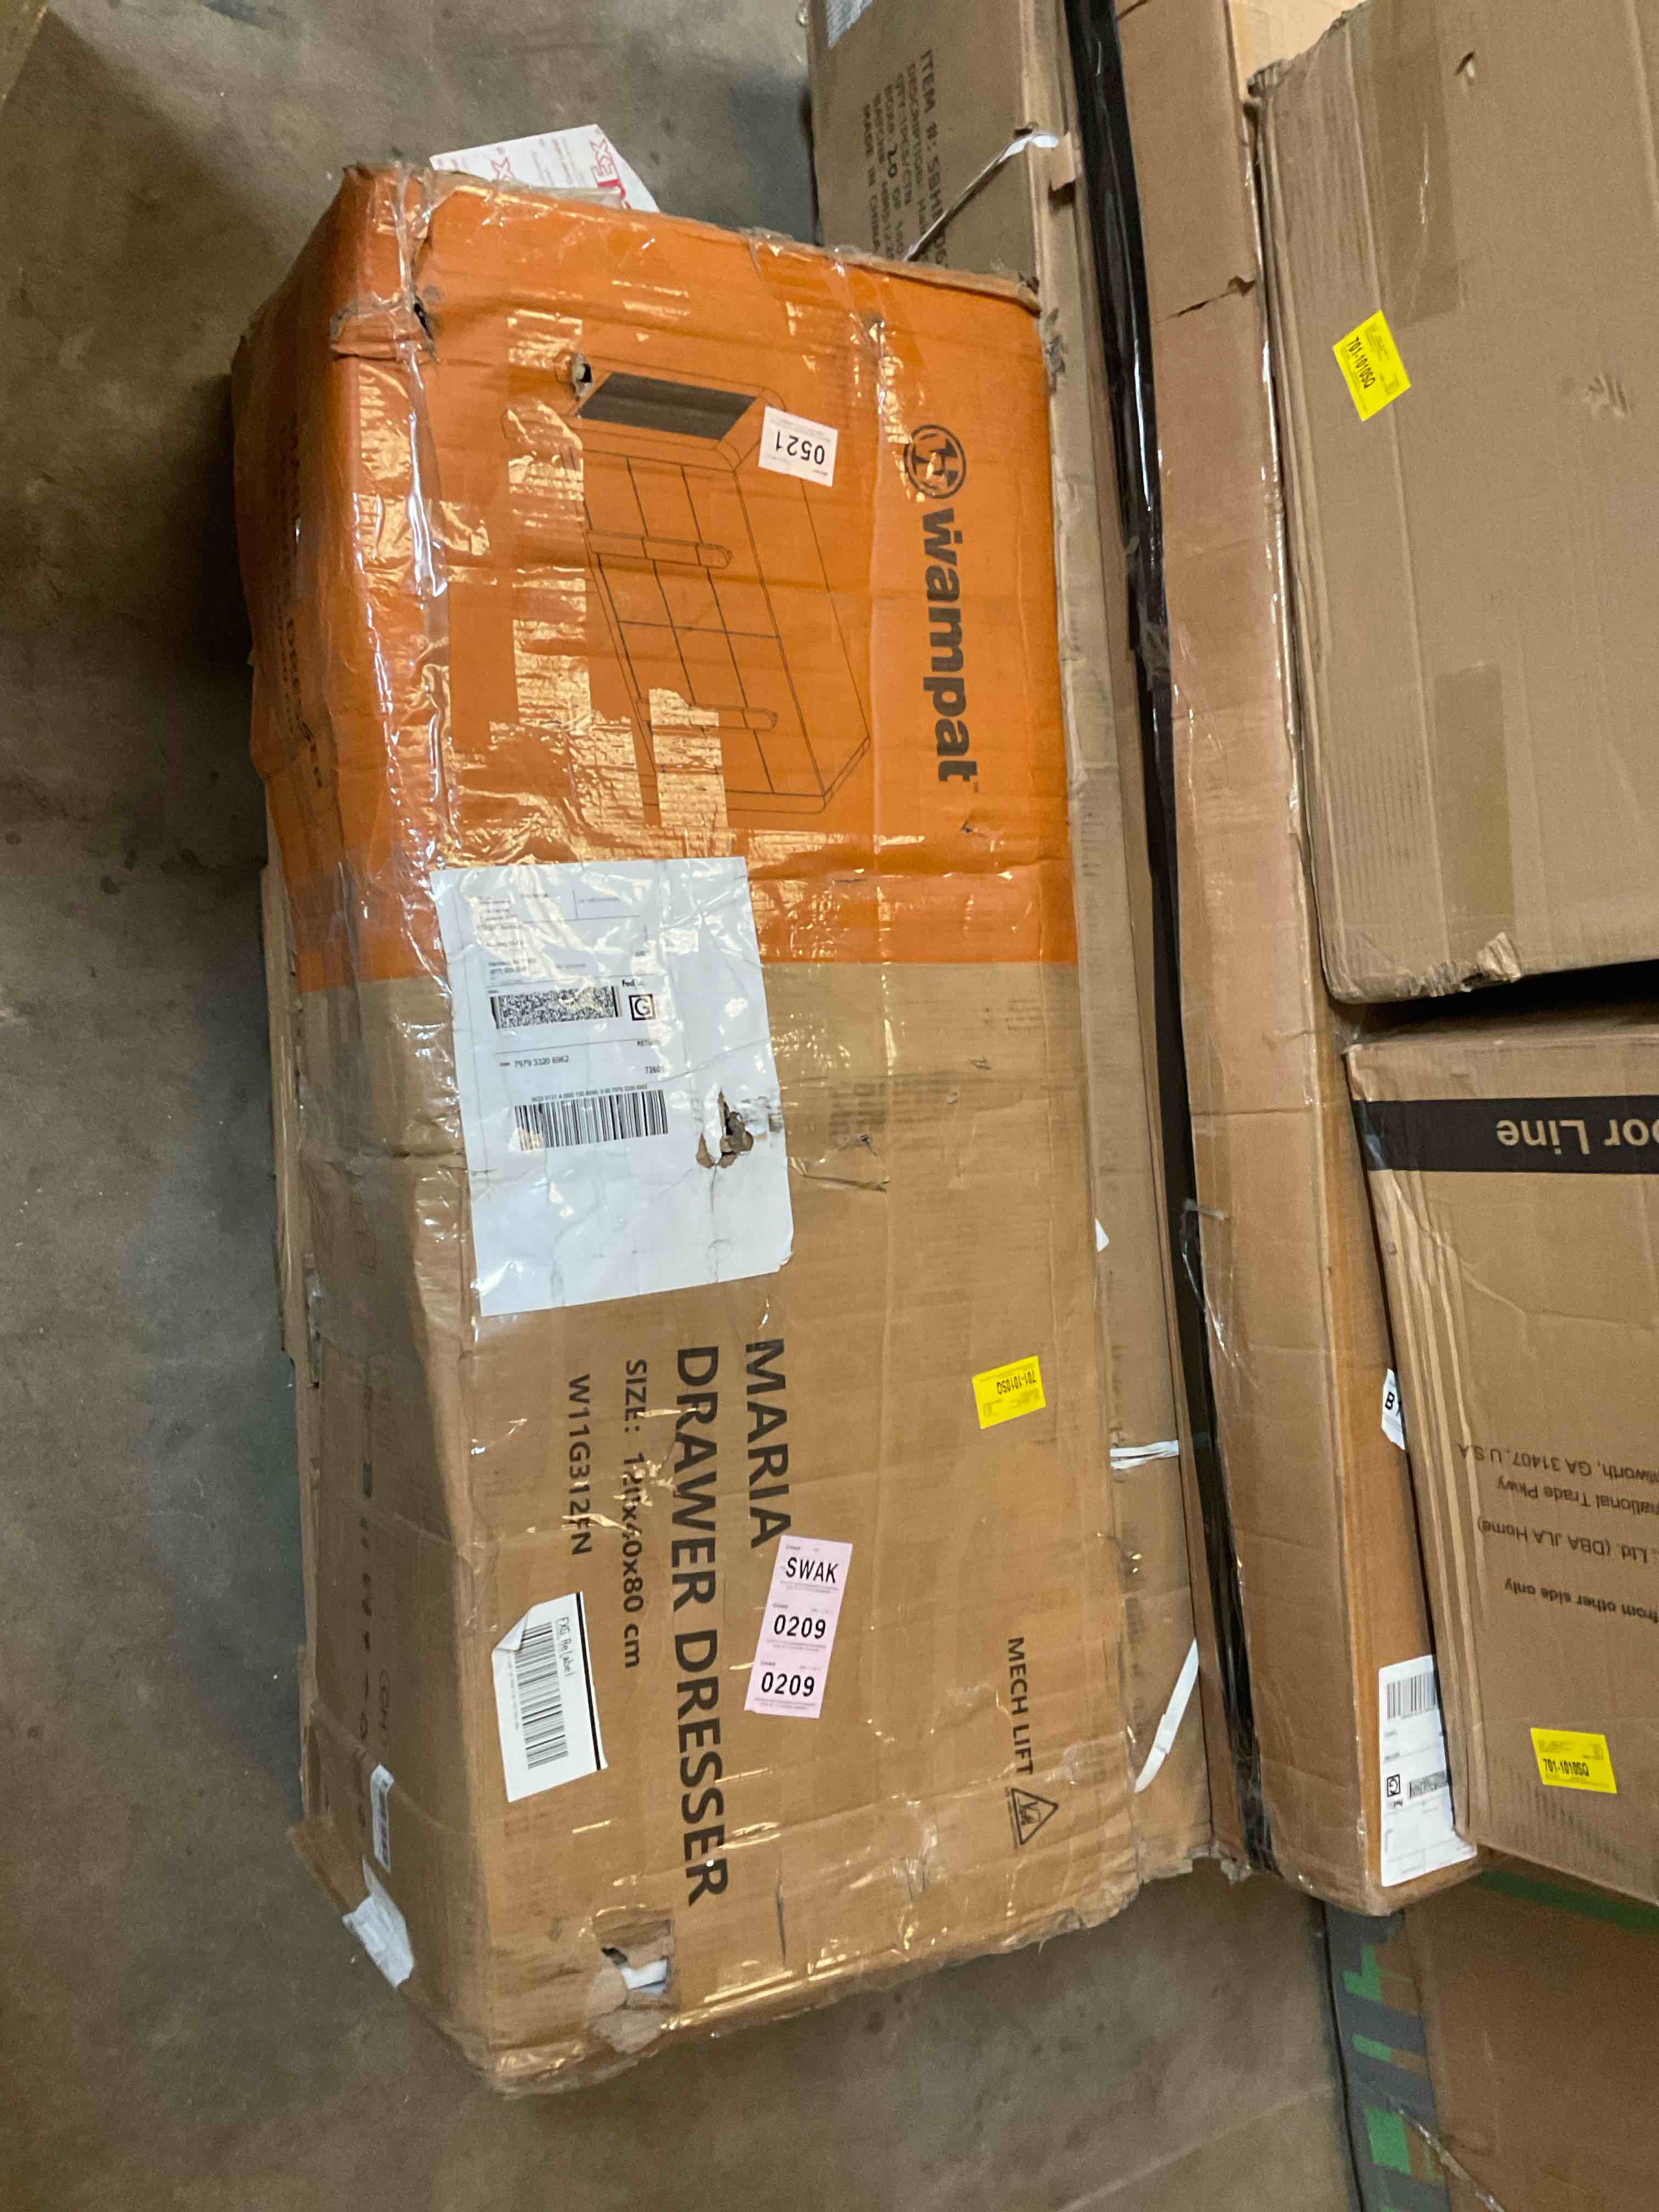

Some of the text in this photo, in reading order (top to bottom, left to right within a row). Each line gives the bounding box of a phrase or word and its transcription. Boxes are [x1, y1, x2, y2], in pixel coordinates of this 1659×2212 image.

[776, 430, 825, 465] 0521
[1496, 1119, 1659, 1155] or Line
[624, 1359, 647, 1433] SIZE:
[745, 1338, 792, 1549] MARIA
[1564, 1457, 1592, 1476] GA
[1497, 1475, 1539, 1498] Pkwy
[1544, 1486, 1591, 1508] Trade
[1477, 1515, 1528, 1543] Home)
[1533, 1528, 1562, 1547] JLA
[1567, 1536, 1611, 1557] (DBA
[786, 1556, 839, 1584] SWAK
[1504, 1577, 1537, 1595] only
[1541, 1587, 1572, 1605] side
[1577, 1594, 1616, 1612] other
[671, 1346, 729, 1907] DRAWER DRESSER
[774, 1615, 827, 1640] 0209
[624, 1623, 640, 1668] cm
[761, 1672, 815, 1697] 0209
[1008, 1637, 1035, 1775] MECH LIFT
